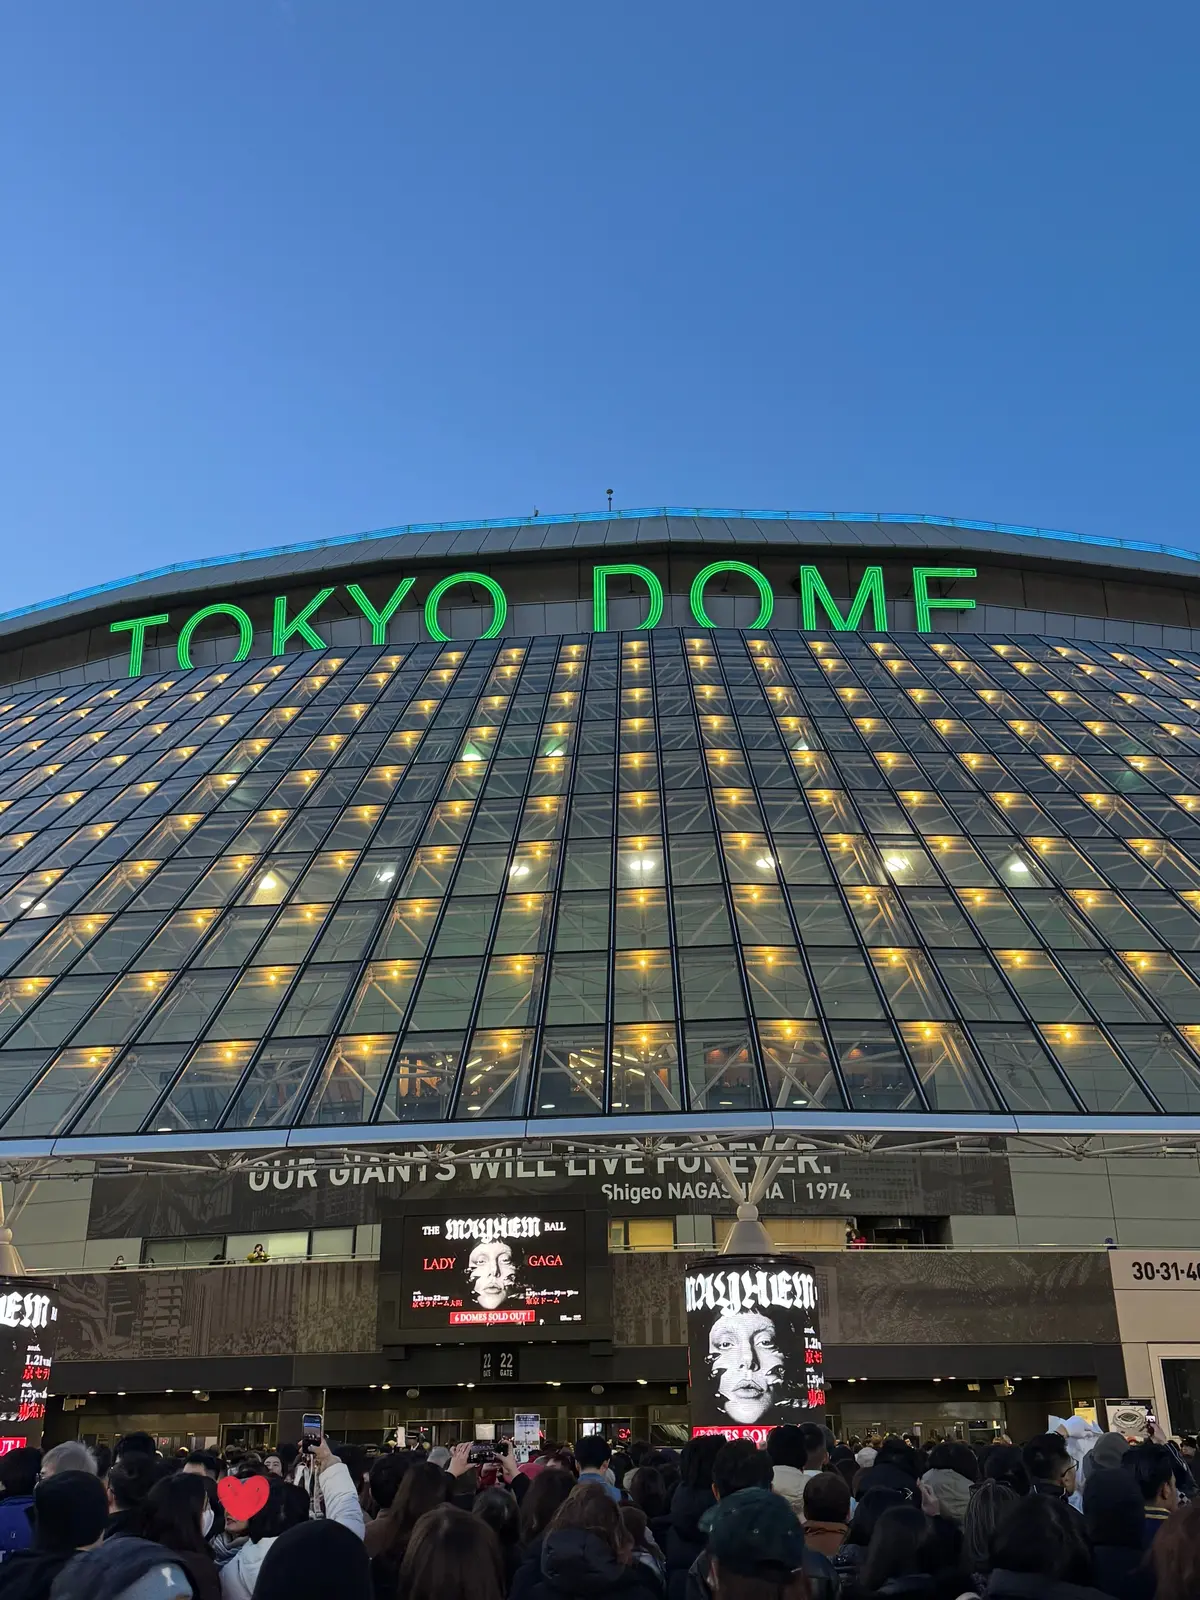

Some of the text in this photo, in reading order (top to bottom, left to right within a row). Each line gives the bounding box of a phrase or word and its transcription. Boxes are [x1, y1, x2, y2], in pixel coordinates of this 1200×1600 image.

[110, 572, 508, 677] TOKYO
[249, 1157, 318, 1192] OUR
[329, 1151, 456, 1186] GIANTS
[468, 1147, 556, 1180] WILL
[567, 1143, 645, 1177] LIVE
[601, 1183, 662, 1205] Shigeo
[806, 1182, 852, 1200] 1974
[422, 1216, 566, 1243] THE MAYHEM BALL
[423, 1255, 563, 1270] LADY GAGA
[460, 1313, 487, 1322] DOMES
[488, 1312, 509, 1321] SOLD
[500, 1352, 513, 1368] 22
[499, 1369, 513, 1377] GATE
